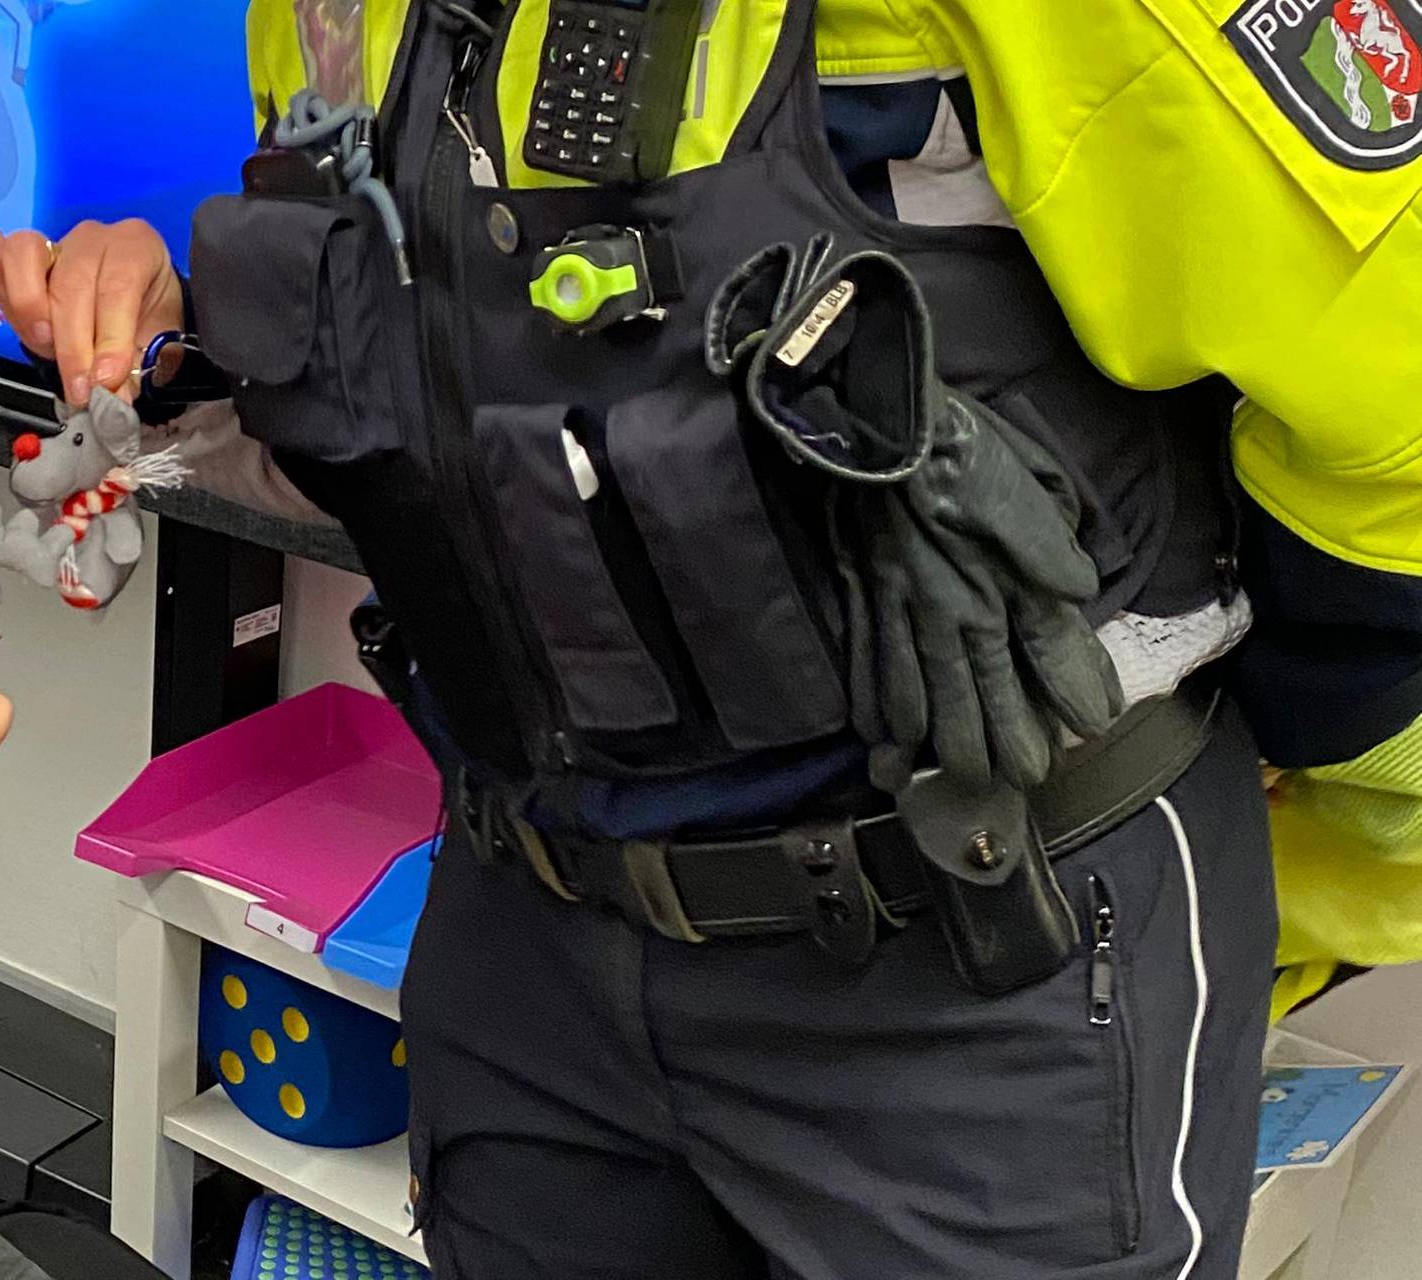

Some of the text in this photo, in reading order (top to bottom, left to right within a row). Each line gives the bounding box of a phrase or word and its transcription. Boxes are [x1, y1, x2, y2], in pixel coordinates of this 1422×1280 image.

[782, 350, 794, 360] 7
[825, 285, 848, 308] BLB
[277, 923, 284, 934] 4
